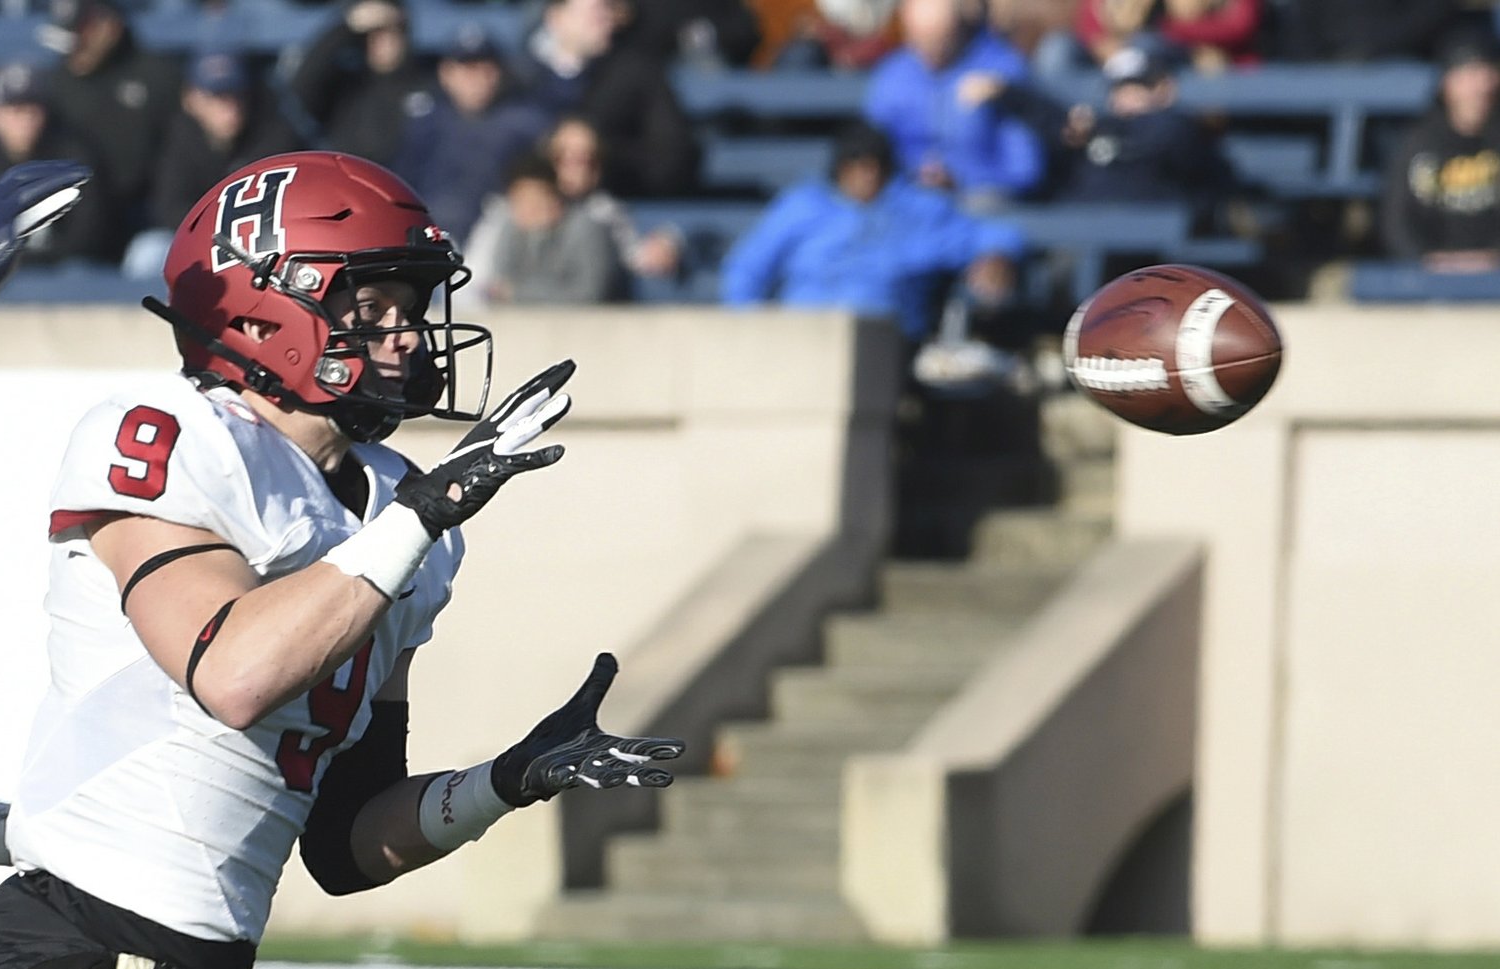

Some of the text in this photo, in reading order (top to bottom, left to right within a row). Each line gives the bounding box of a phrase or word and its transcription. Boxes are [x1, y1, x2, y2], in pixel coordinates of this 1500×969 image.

[211, 166, 298, 274] H
[107, 404, 182, 502] 9
[274, 633, 375, 794] 9
